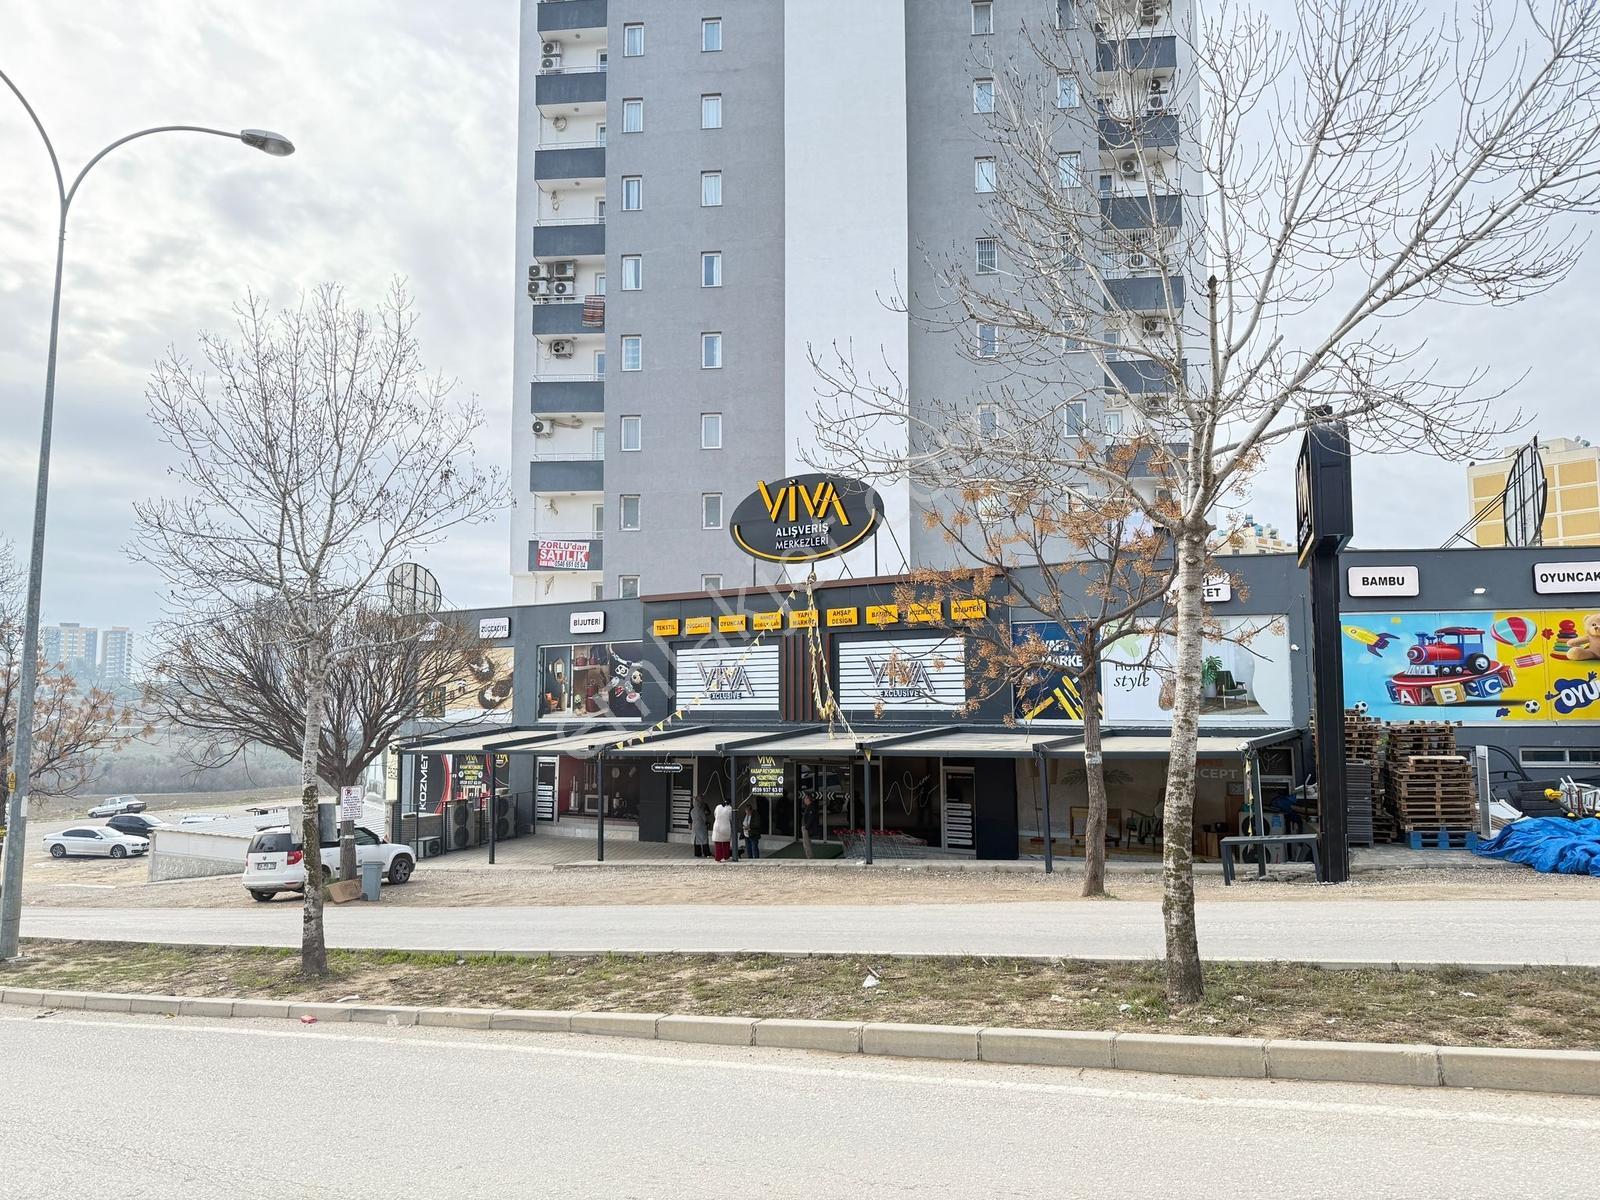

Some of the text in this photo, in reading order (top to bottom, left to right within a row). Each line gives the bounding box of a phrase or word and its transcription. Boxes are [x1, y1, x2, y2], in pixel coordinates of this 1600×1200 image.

[757, 479, 850, 526] VİVA
[775, 522, 829, 538] ALIŞVERİŞ
[540, 541, 587, 550] ZORLU'dan
[775, 535, 829, 550] MERKEZLERİ
[539, 549, 586, 562] SATILIK
[1361, 576, 1405, 586] BAMBU
[1540, 573, 1600, 584] OYUNCAK
[832, 609, 851, 617] AHŞAP
[573, 617, 601, 627] BİJUTERİ
[1042, 655, 1083, 668] MARKE
[1113, 672, 1150, 692] style
[1440, 688, 1457, 701] B
[1484, 679, 1501, 694] C
